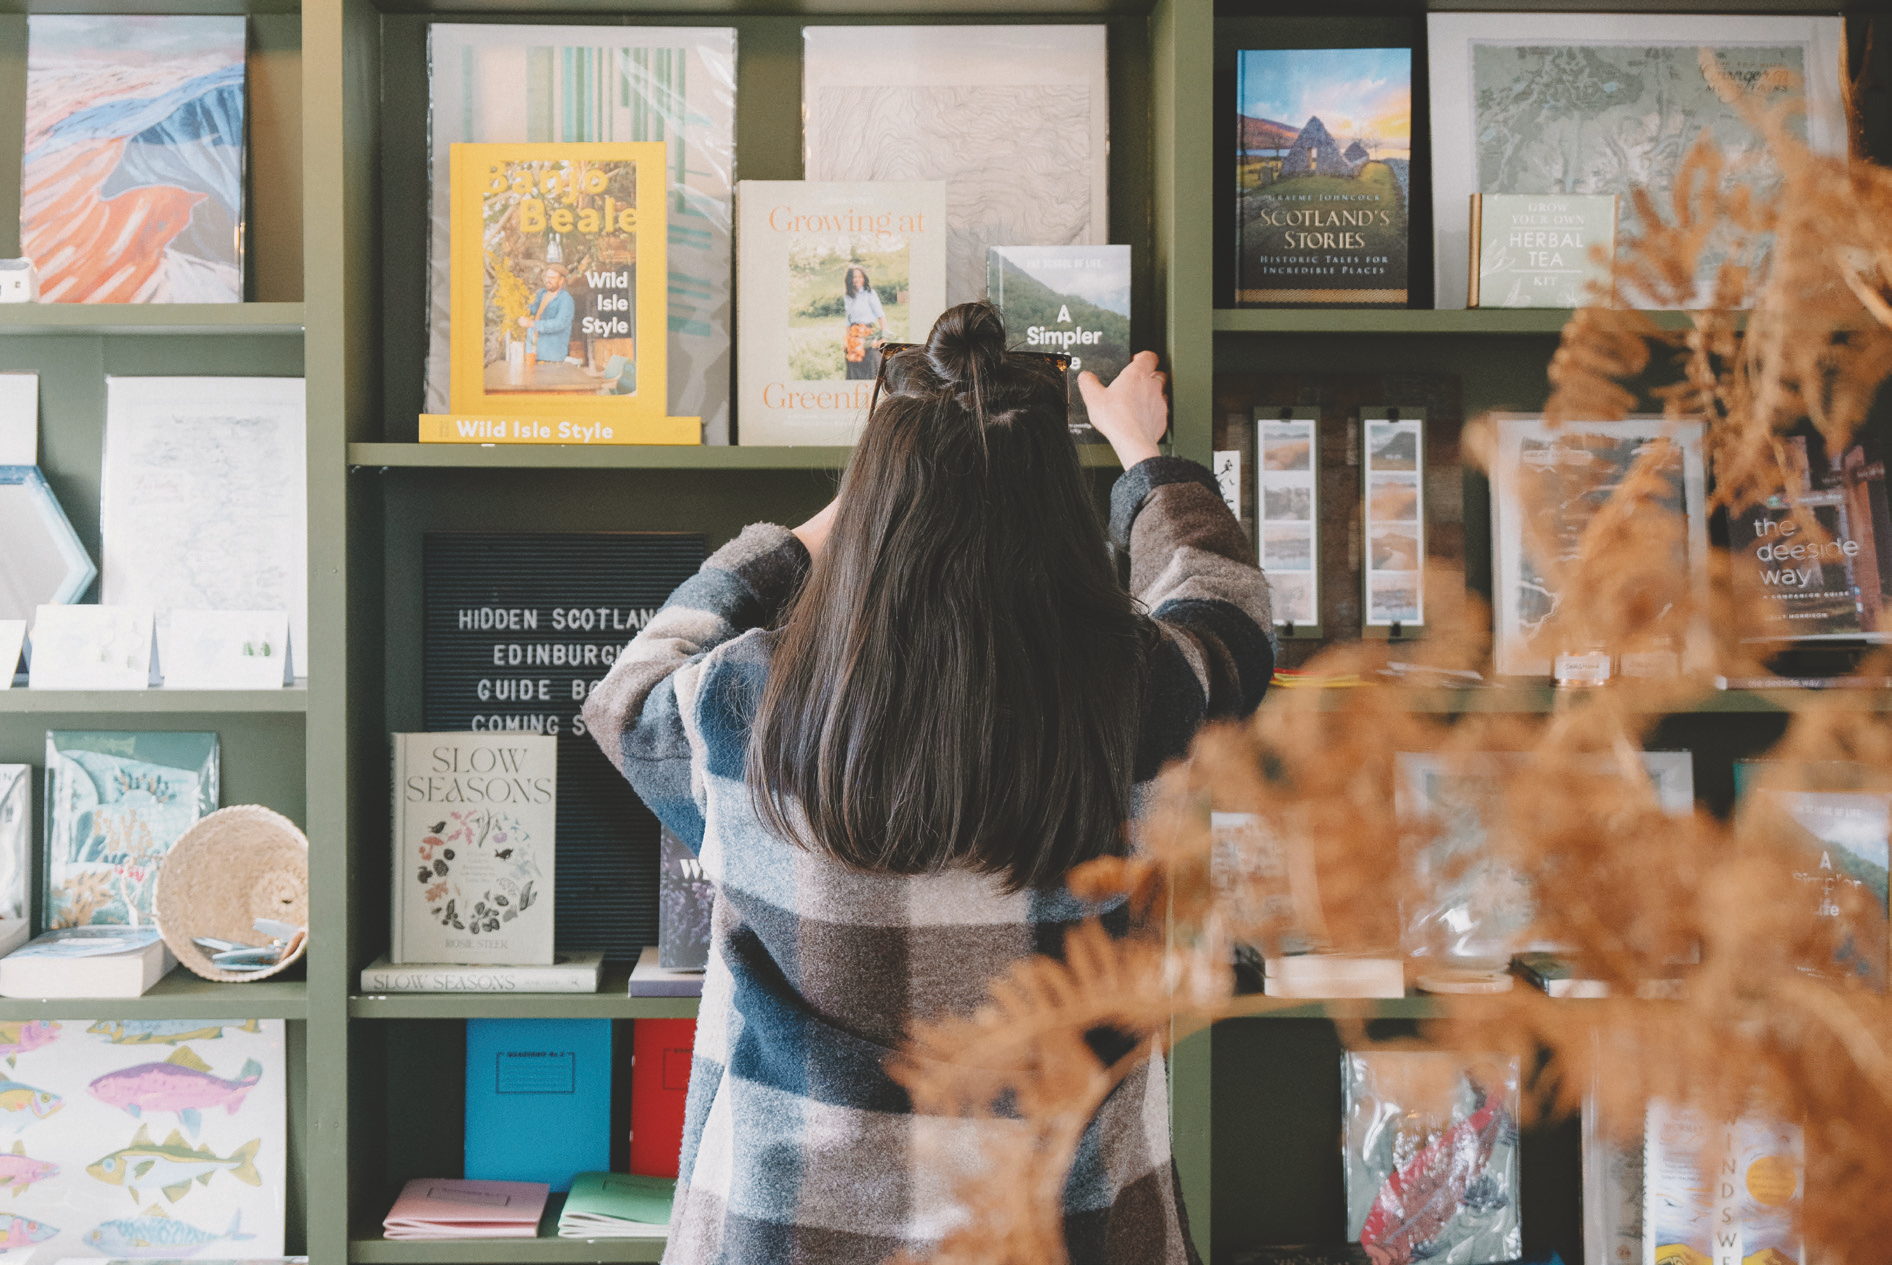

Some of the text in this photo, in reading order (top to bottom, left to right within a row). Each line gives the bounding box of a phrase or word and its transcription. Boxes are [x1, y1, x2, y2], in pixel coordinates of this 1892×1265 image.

[519, 197, 639, 233] Beale
[769, 205, 926, 239] Growing at
[1260, 209, 1391, 227] SCOTLAND'S
[1284, 231, 1366, 249] STORIES
[1509, 232, 1584, 248] HERBAL
[1260, 255, 1389, 264] HISTORIC TALES FOR
[1528, 251, 1564, 267] TEA
[585, 271, 628, 289] Wild
[1263, 266, 1385, 275] INCREDIBLE PLACES
[597, 294, 629, 312] Isle
[1057, 304, 1072, 323] A
[582, 316, 629, 338] Style
[1027, 326, 1103, 350] Simpler
[456, 420, 506, 438] Wild
[513, 421, 552, 439] Isle
[558, 421, 614, 443] Style
[1753, 517, 1796, 537] the
[1756, 537, 1860, 562] deeside
[1760, 567, 1812, 588] way
[458, 607, 538, 630] HIDDEN
[477, 679, 551, 701] GUIDE
[472, 714, 560, 735] COMING
[432, 746, 528, 773] SLOW
[406, 776, 552, 804] SEASONS
[1819, 850, 1833, 870] A
[373, 975, 516, 991] SLOW SEASONS
